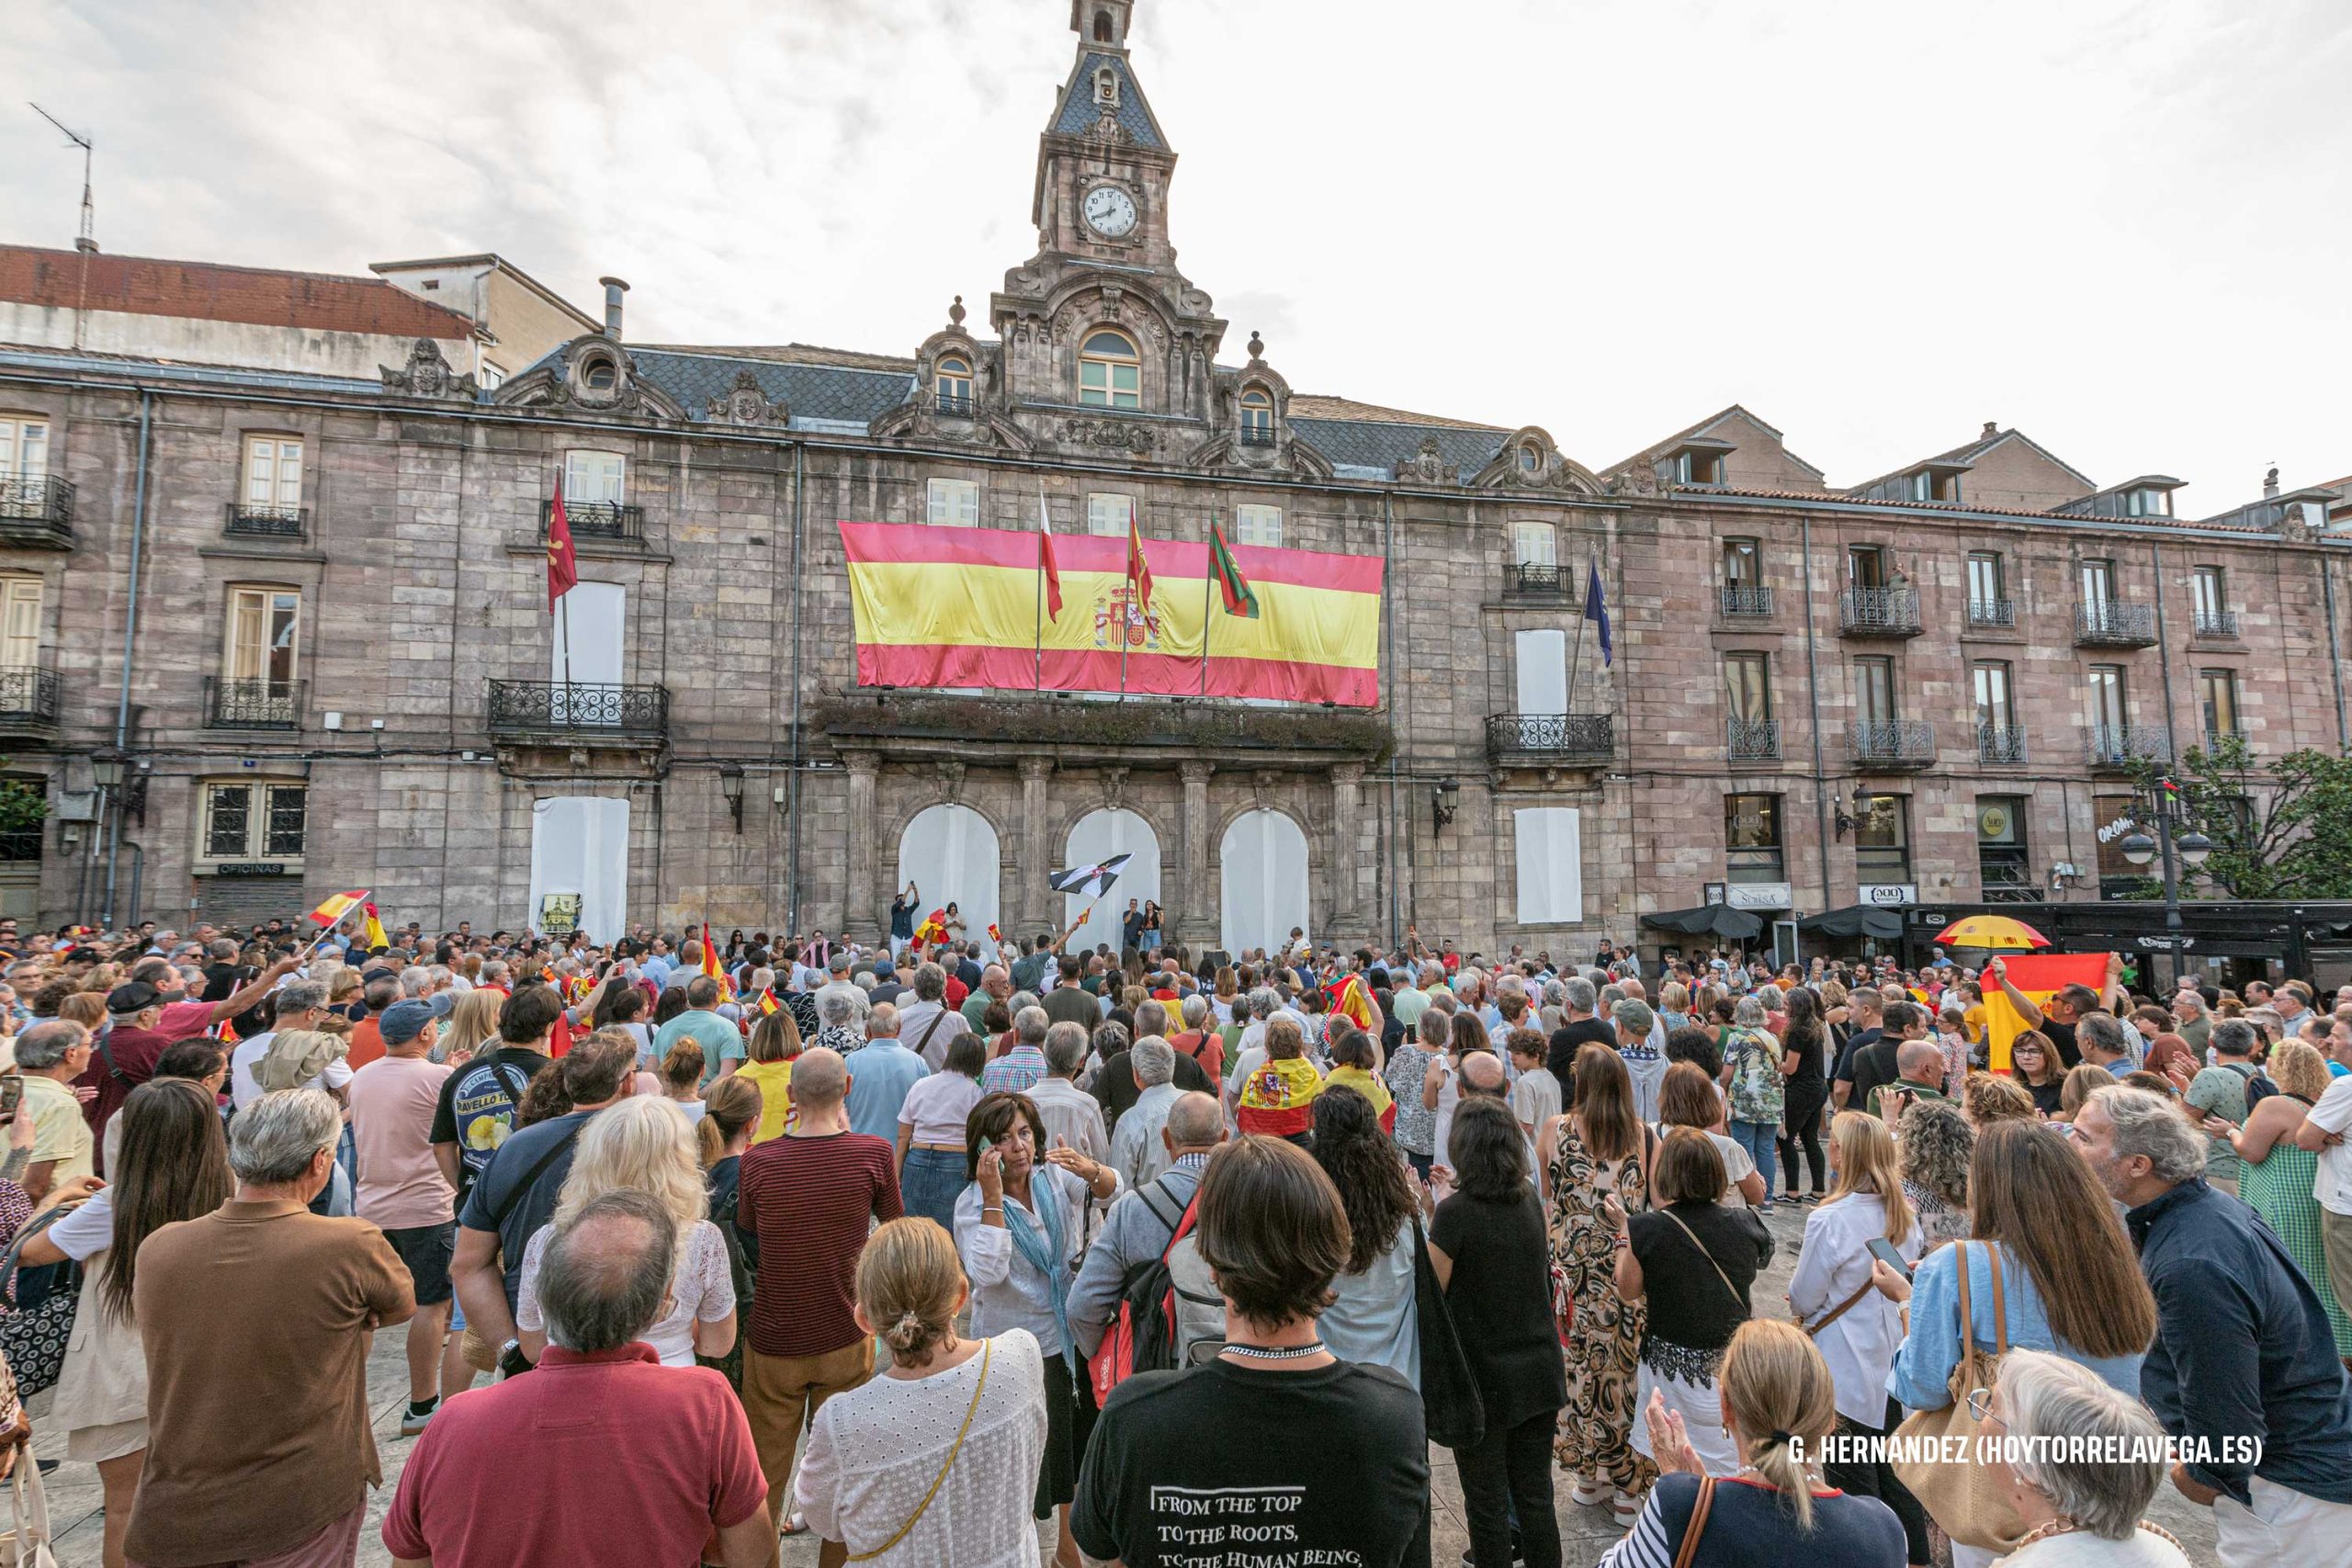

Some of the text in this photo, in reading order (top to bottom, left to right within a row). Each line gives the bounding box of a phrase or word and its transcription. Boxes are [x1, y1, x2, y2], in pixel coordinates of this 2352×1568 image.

[220, 864, 280, 874] OFICINAS
[1158, 1495, 1302, 1515] FROM THE TOP
[1158, 1525, 1298, 1545] TO THE ROOTS,
[1227, 1551, 1300, 1568] HUMAN
[1303, 1549, 1363, 1567] BEING,
